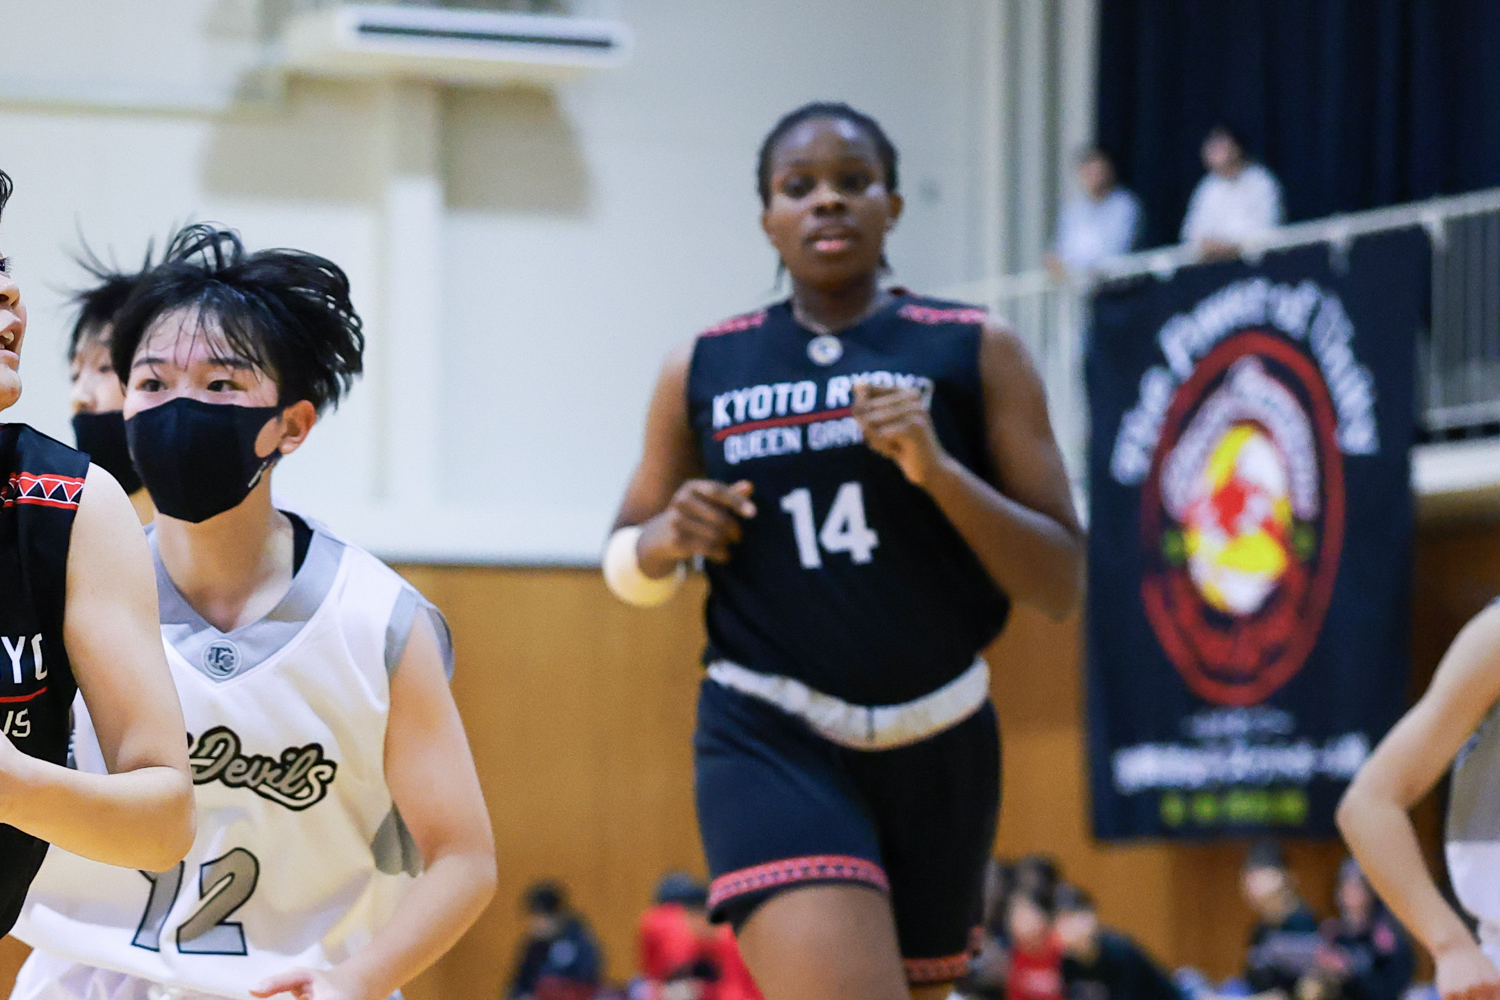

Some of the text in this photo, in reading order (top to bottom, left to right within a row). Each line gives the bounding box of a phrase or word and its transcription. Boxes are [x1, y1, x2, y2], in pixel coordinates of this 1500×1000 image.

[712, 379, 818, 430] KYOTO
[722, 425, 803, 466] QUEEN
[780, 481, 880, 570] 14
[189, 725, 338, 811] Devils
[131, 846, 260, 956] 12
